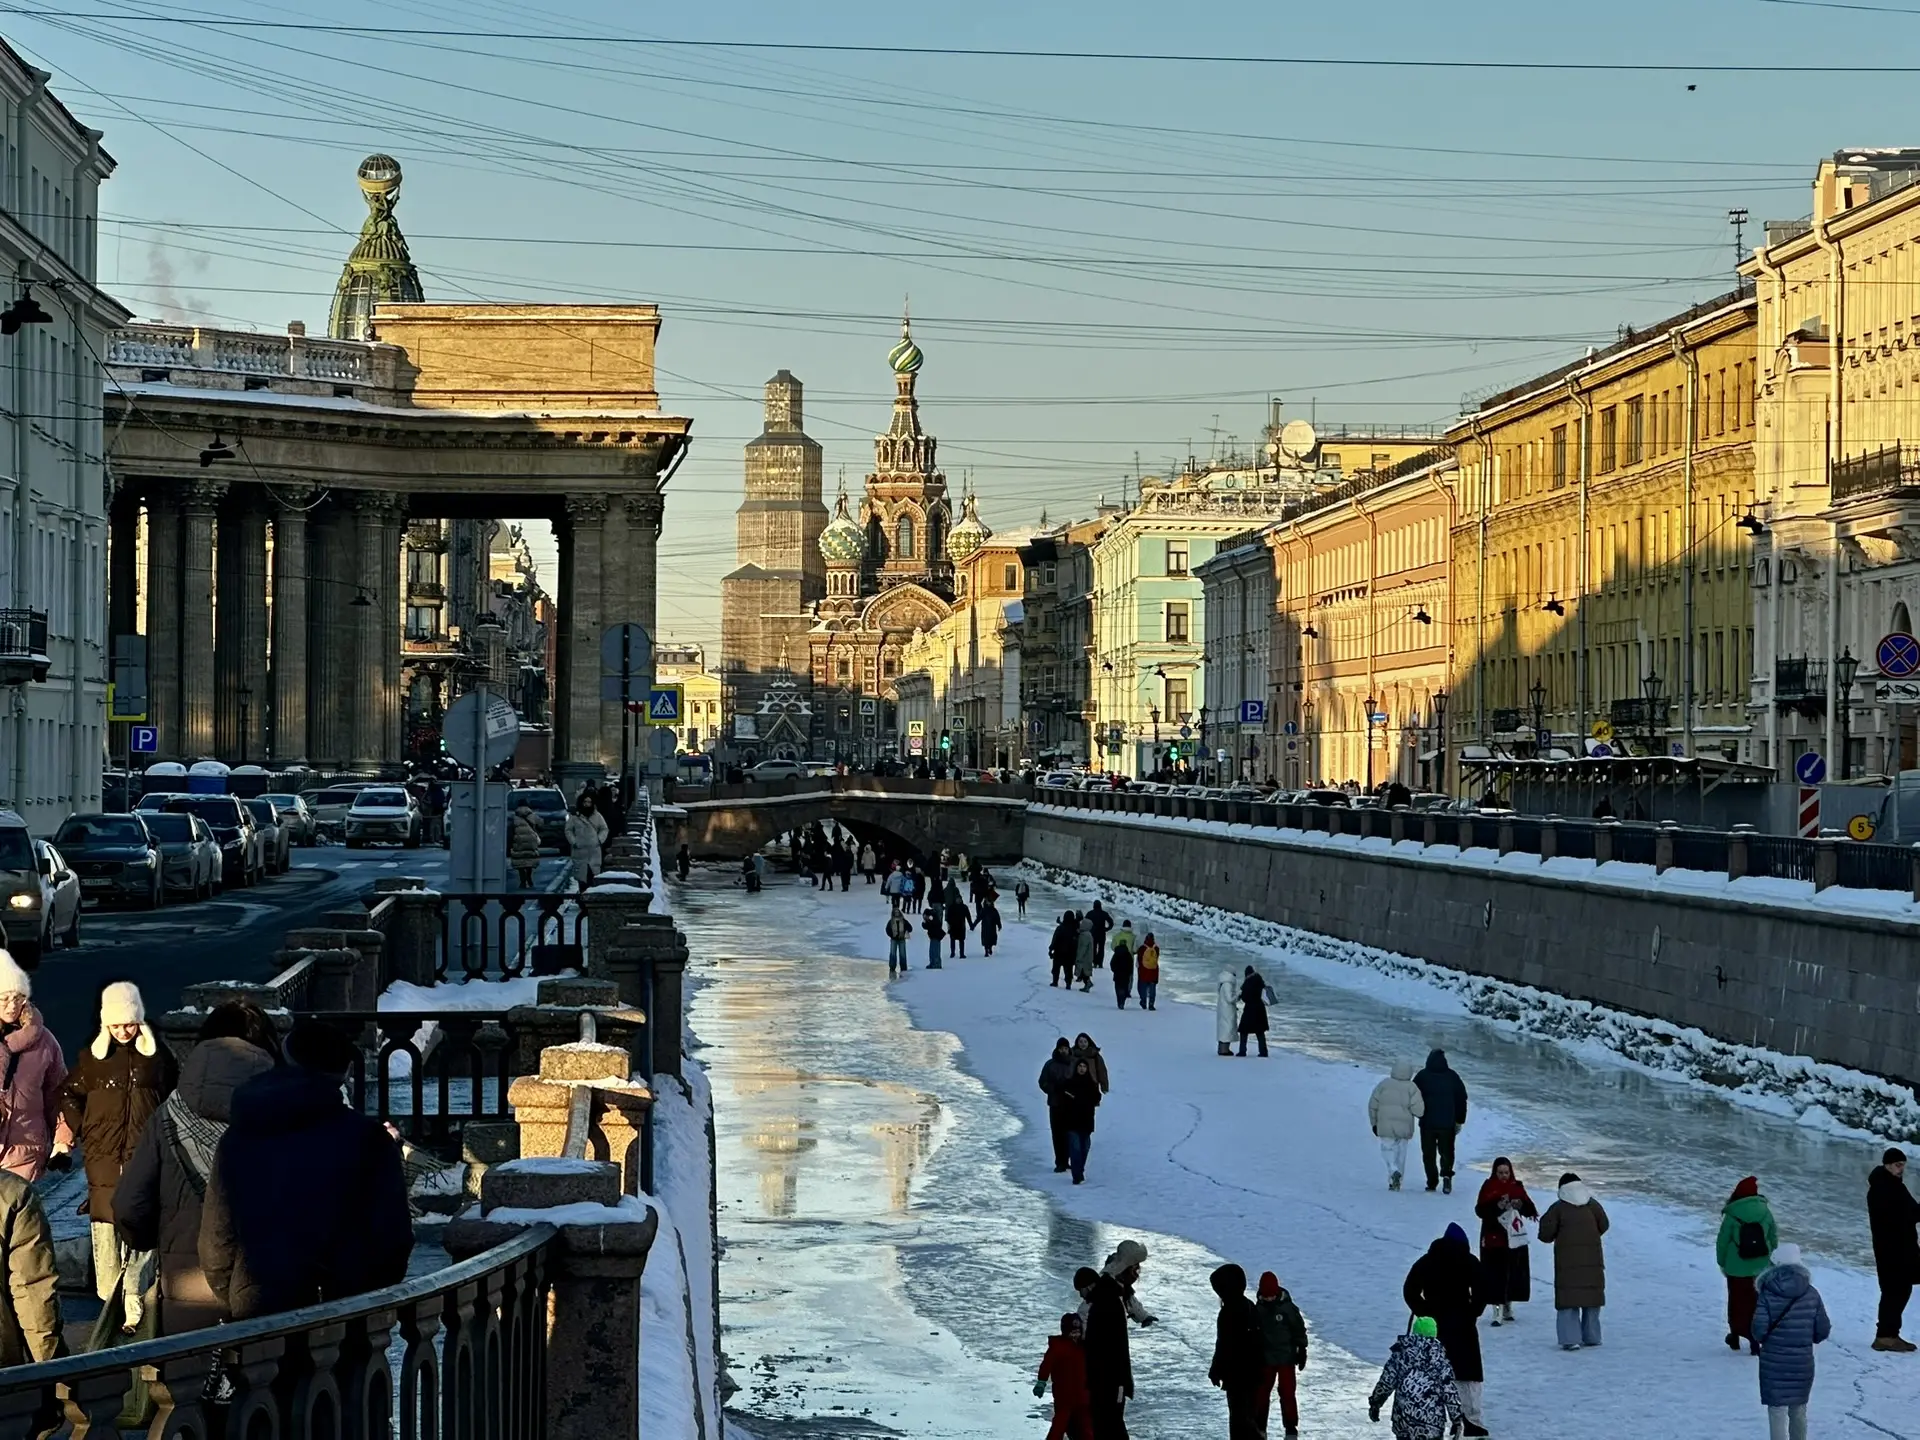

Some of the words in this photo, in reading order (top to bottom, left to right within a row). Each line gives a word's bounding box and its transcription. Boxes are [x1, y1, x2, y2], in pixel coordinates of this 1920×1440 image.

[1247, 702, 1260, 720] P
[138, 729, 153, 749] P
[1541, 731, 1550, 748] P
[1595, 727, 1610, 736] 40
[1857, 822, 1865, 833] 5
